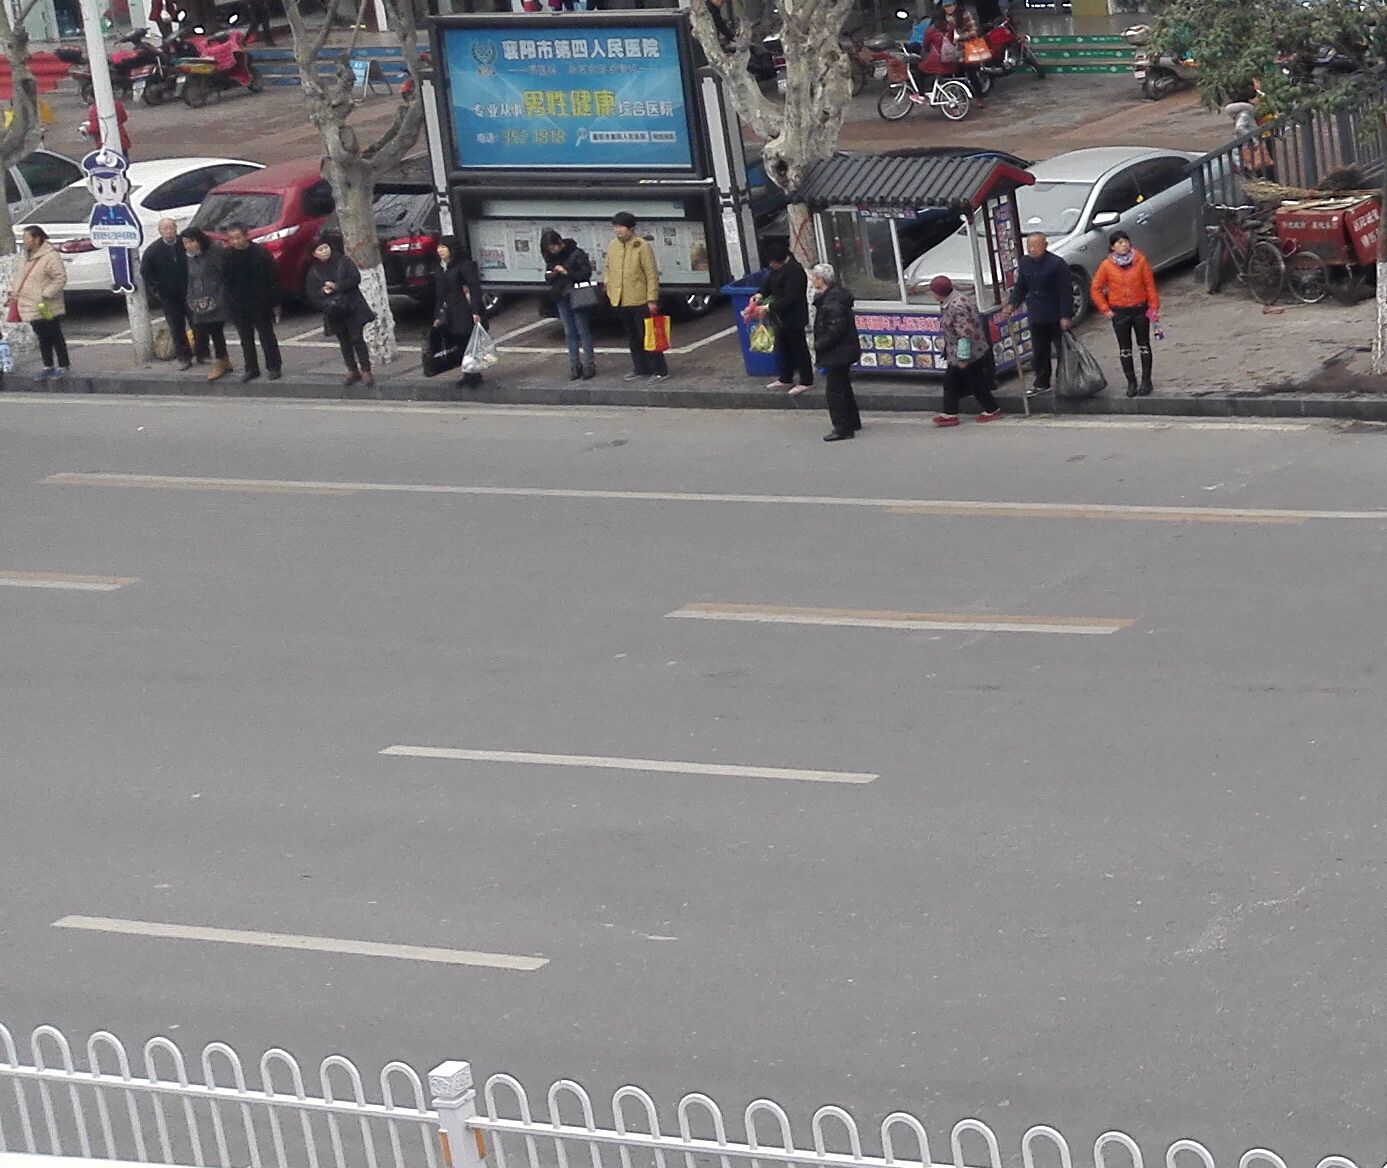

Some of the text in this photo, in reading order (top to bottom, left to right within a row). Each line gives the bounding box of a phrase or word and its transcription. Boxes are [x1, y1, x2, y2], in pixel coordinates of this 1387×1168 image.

[501, 38, 661, 60] 襄阳市第四人民医院
